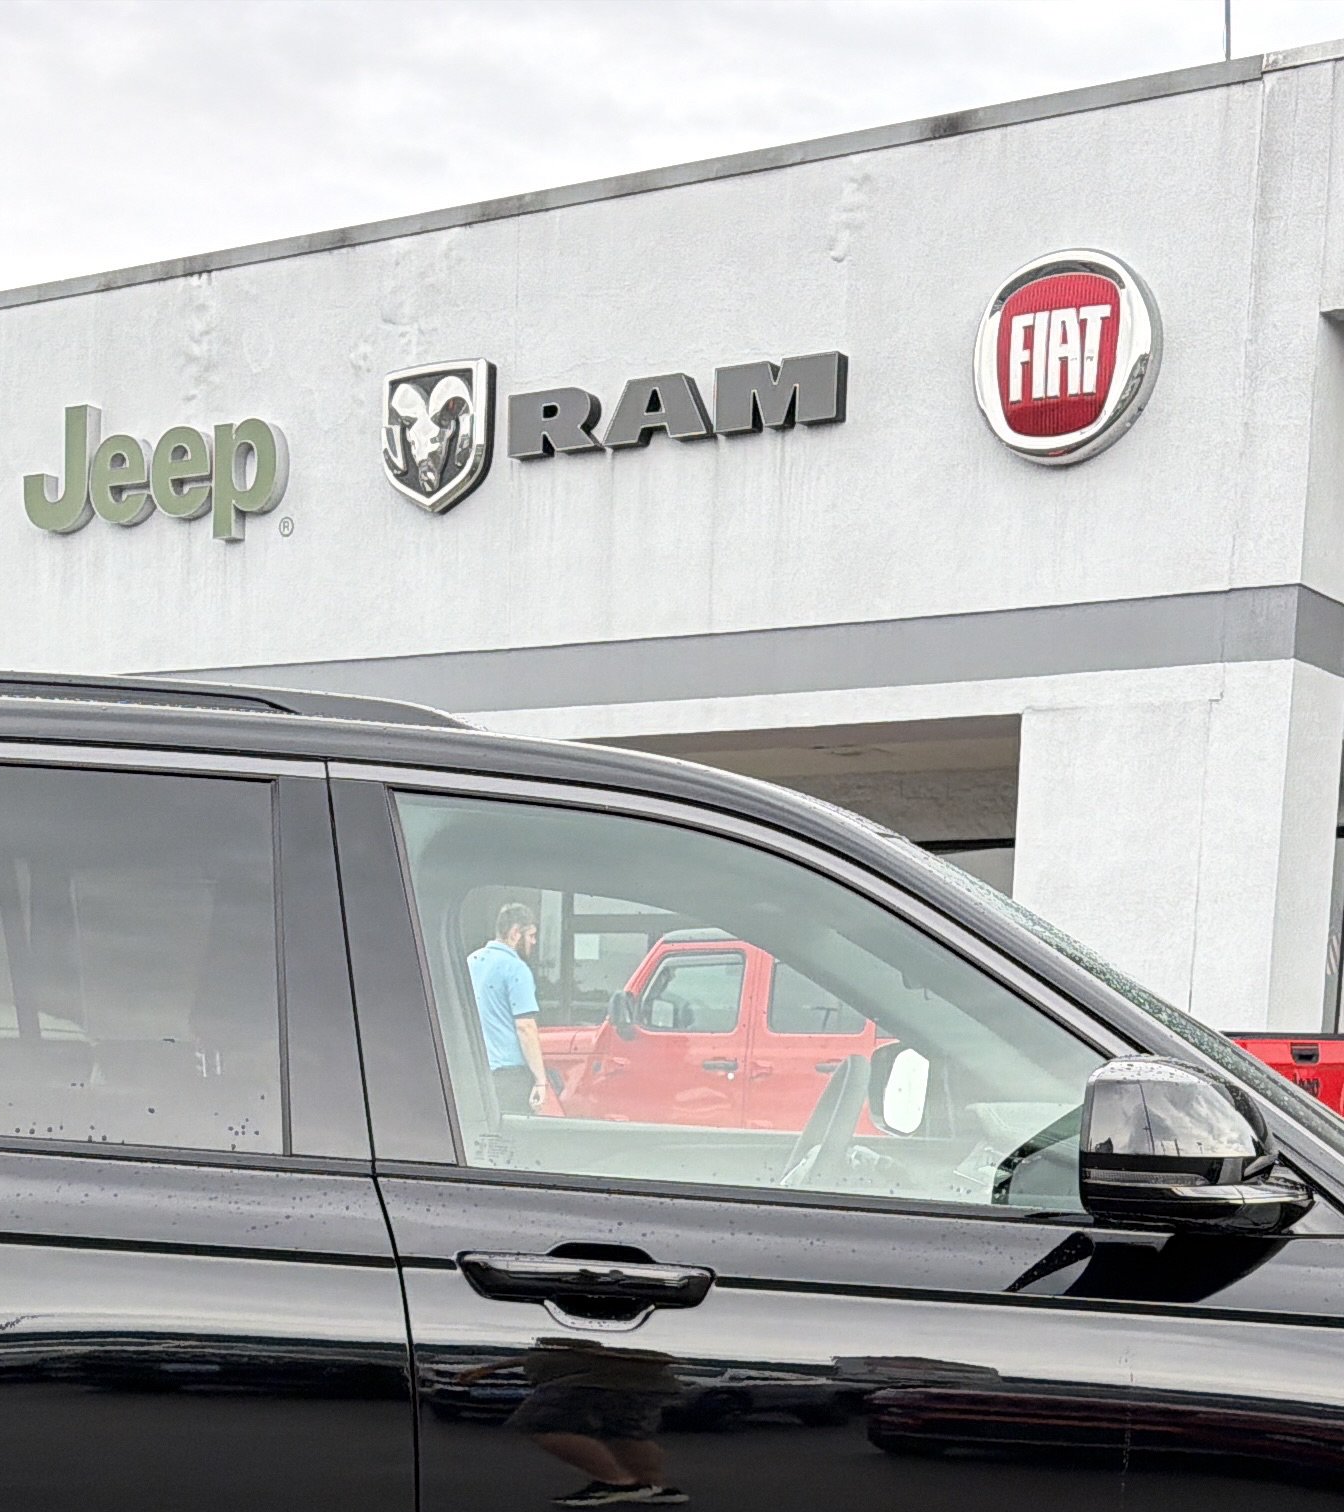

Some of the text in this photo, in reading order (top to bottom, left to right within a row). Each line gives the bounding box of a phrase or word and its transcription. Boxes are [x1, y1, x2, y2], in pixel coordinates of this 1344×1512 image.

[508, 350, 849, 461] RAM
[1010, 304, 1112, 405] FIAT
[23, 404, 290, 542] Jeep
